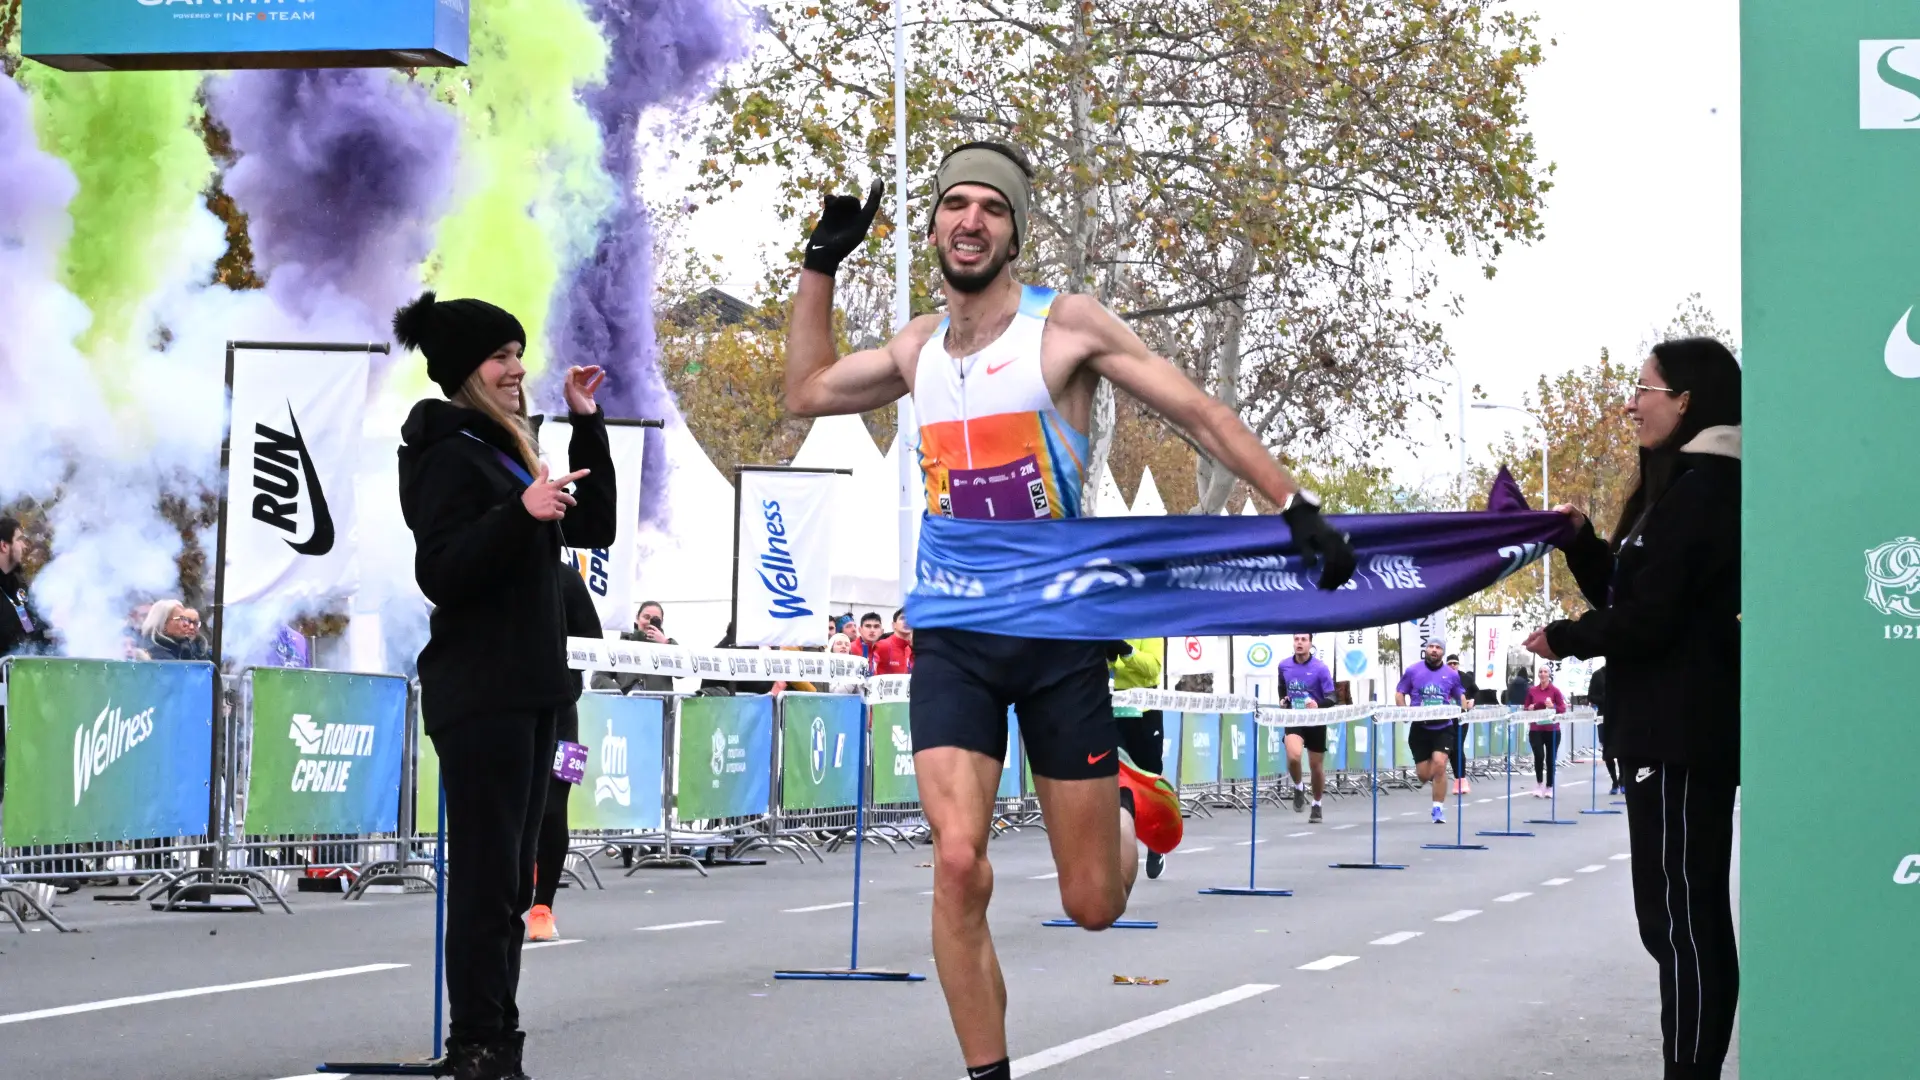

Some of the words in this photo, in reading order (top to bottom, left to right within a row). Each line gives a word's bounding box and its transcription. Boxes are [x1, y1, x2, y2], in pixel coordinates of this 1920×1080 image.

[252, 422, 303, 534] RUN
[985, 497, 995, 517] 1
[755, 499, 814, 619] Wellness
[73, 698, 156, 807] Wellness
[321, 723, 375, 757] ПОШТА
[291, 759, 352, 793] СРБИЈЕ
